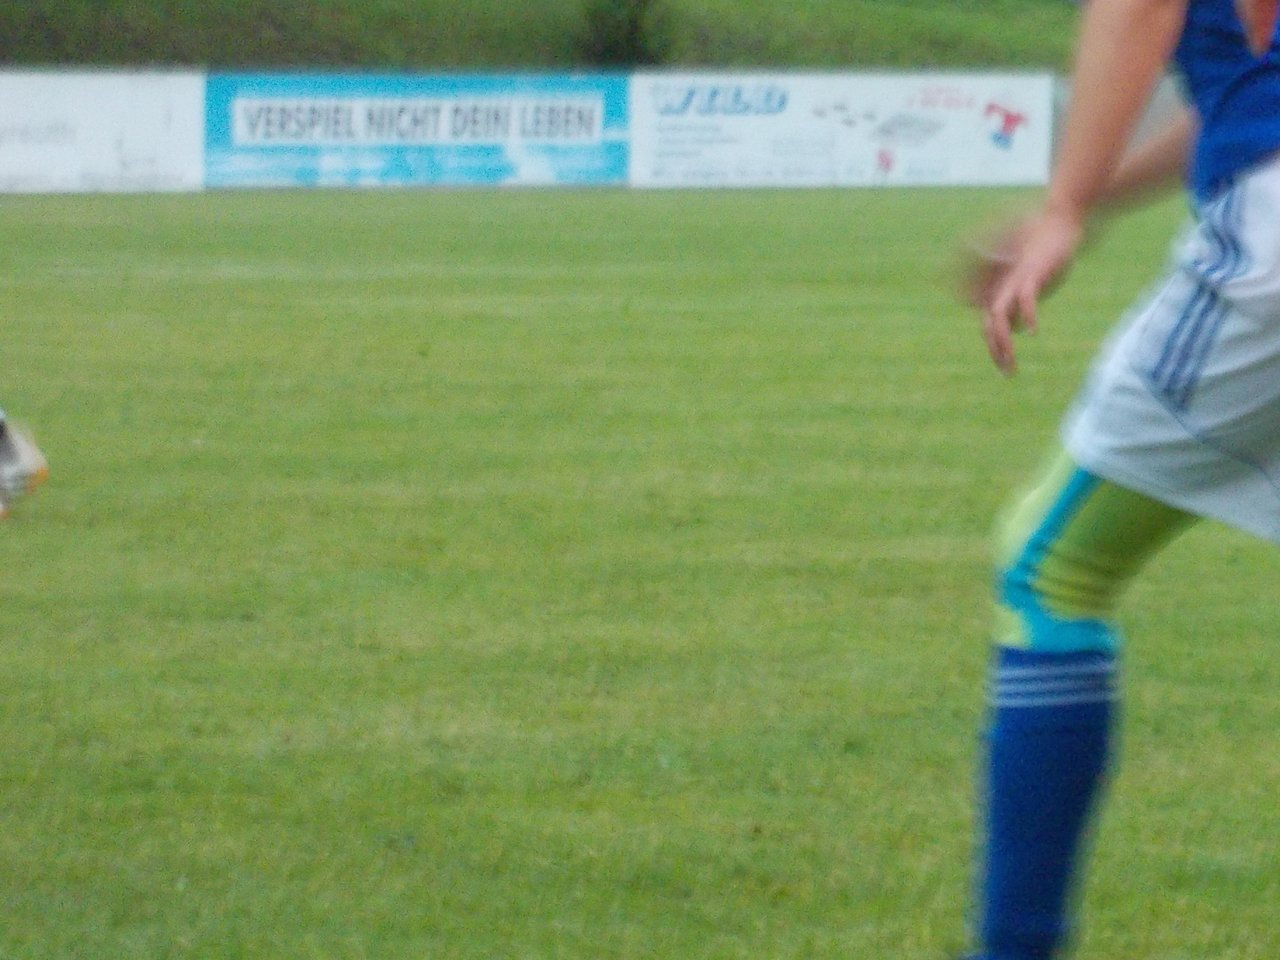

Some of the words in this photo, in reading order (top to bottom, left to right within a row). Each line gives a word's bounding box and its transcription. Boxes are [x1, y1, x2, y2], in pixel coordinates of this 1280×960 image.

[243, 105, 356, 140] VERSPIEL
[366, 105, 442, 139] NICHT
[450, 105, 506, 139] DEIN
[519, 105, 597, 139] LEBEN
